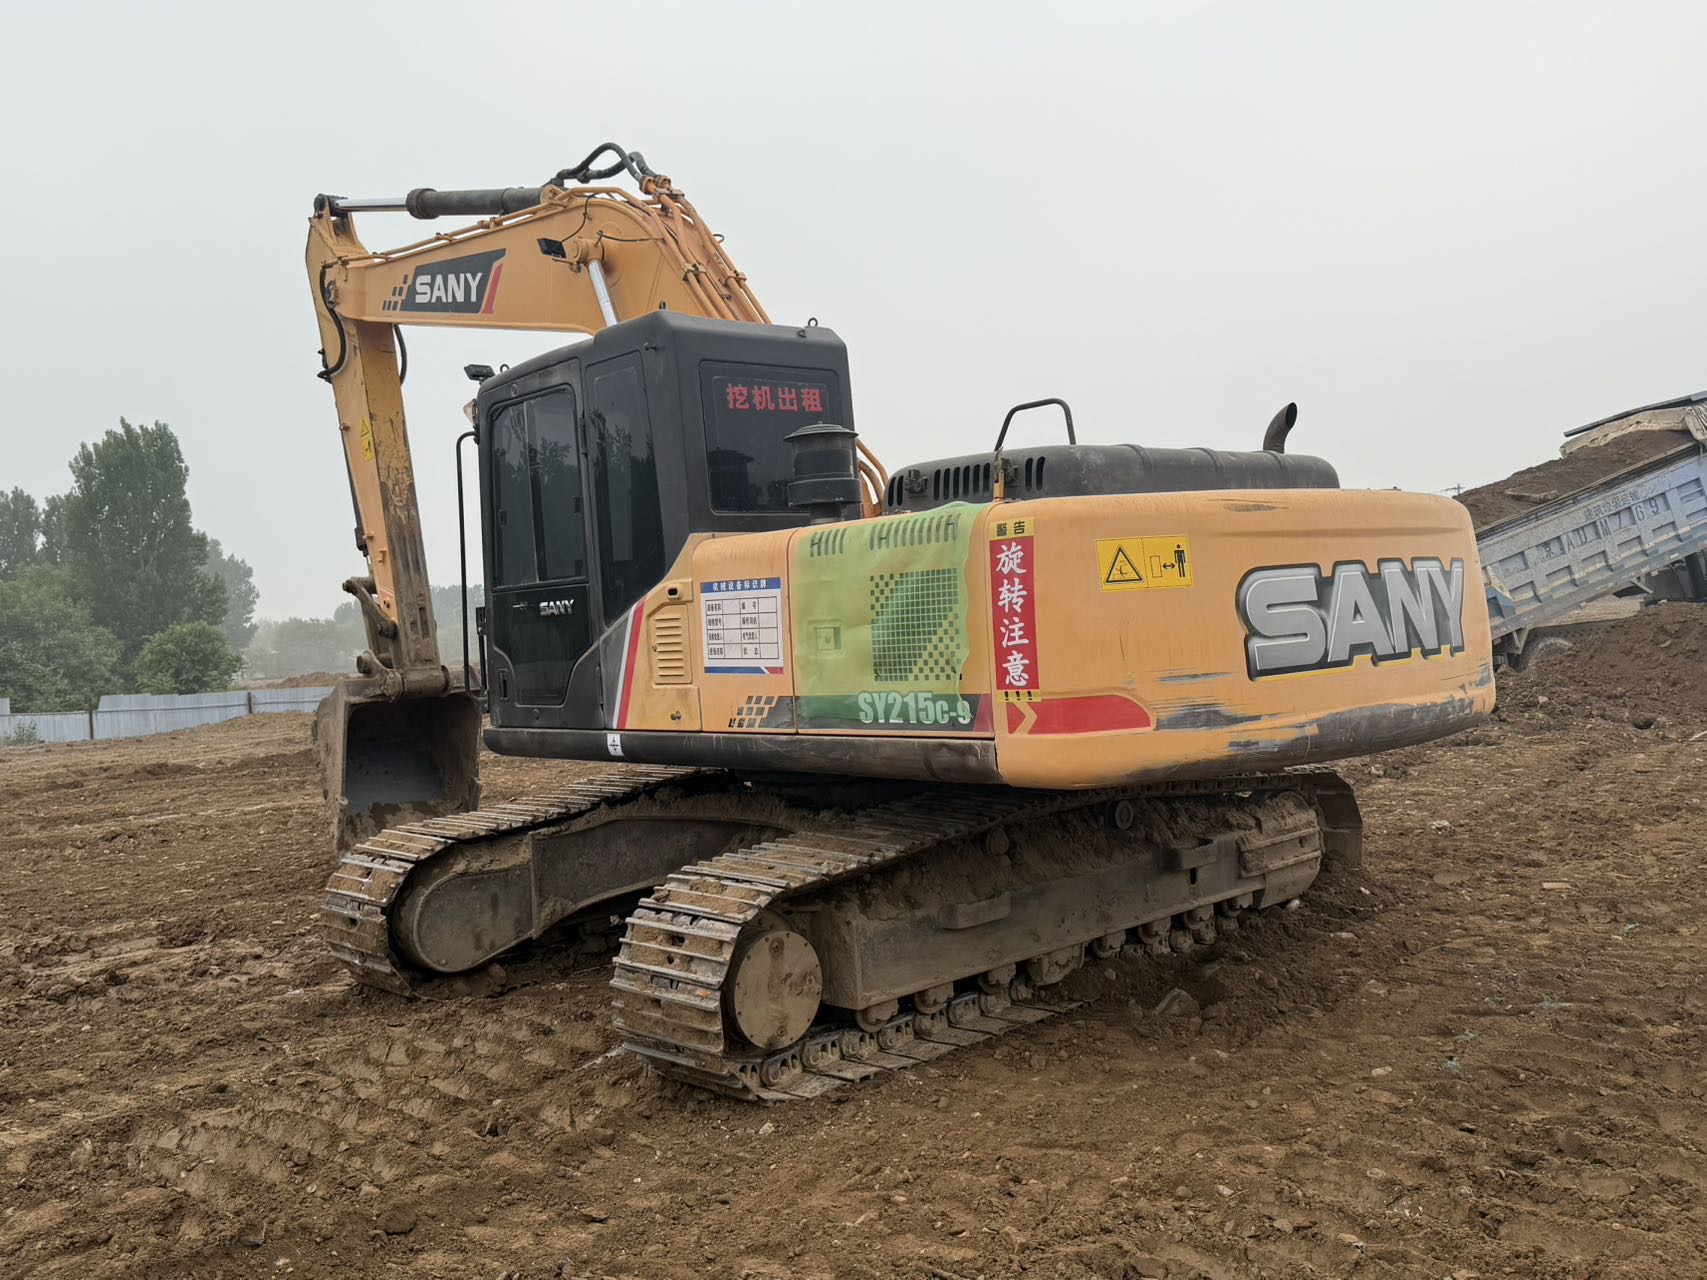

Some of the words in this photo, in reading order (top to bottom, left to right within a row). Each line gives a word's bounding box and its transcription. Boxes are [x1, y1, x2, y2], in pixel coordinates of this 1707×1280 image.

[415, 271, 482, 304] SANY
[726, 383, 824, 412] 挖机出租
[996, 521, 1025, 537] 警告
[712, 579, 767, 591] 机械设备标识牌
[539, 599, 575, 617] SANY
[996, 541, 1030, 687] 旋转注意
[1237, 559, 1465, 676] SANY
